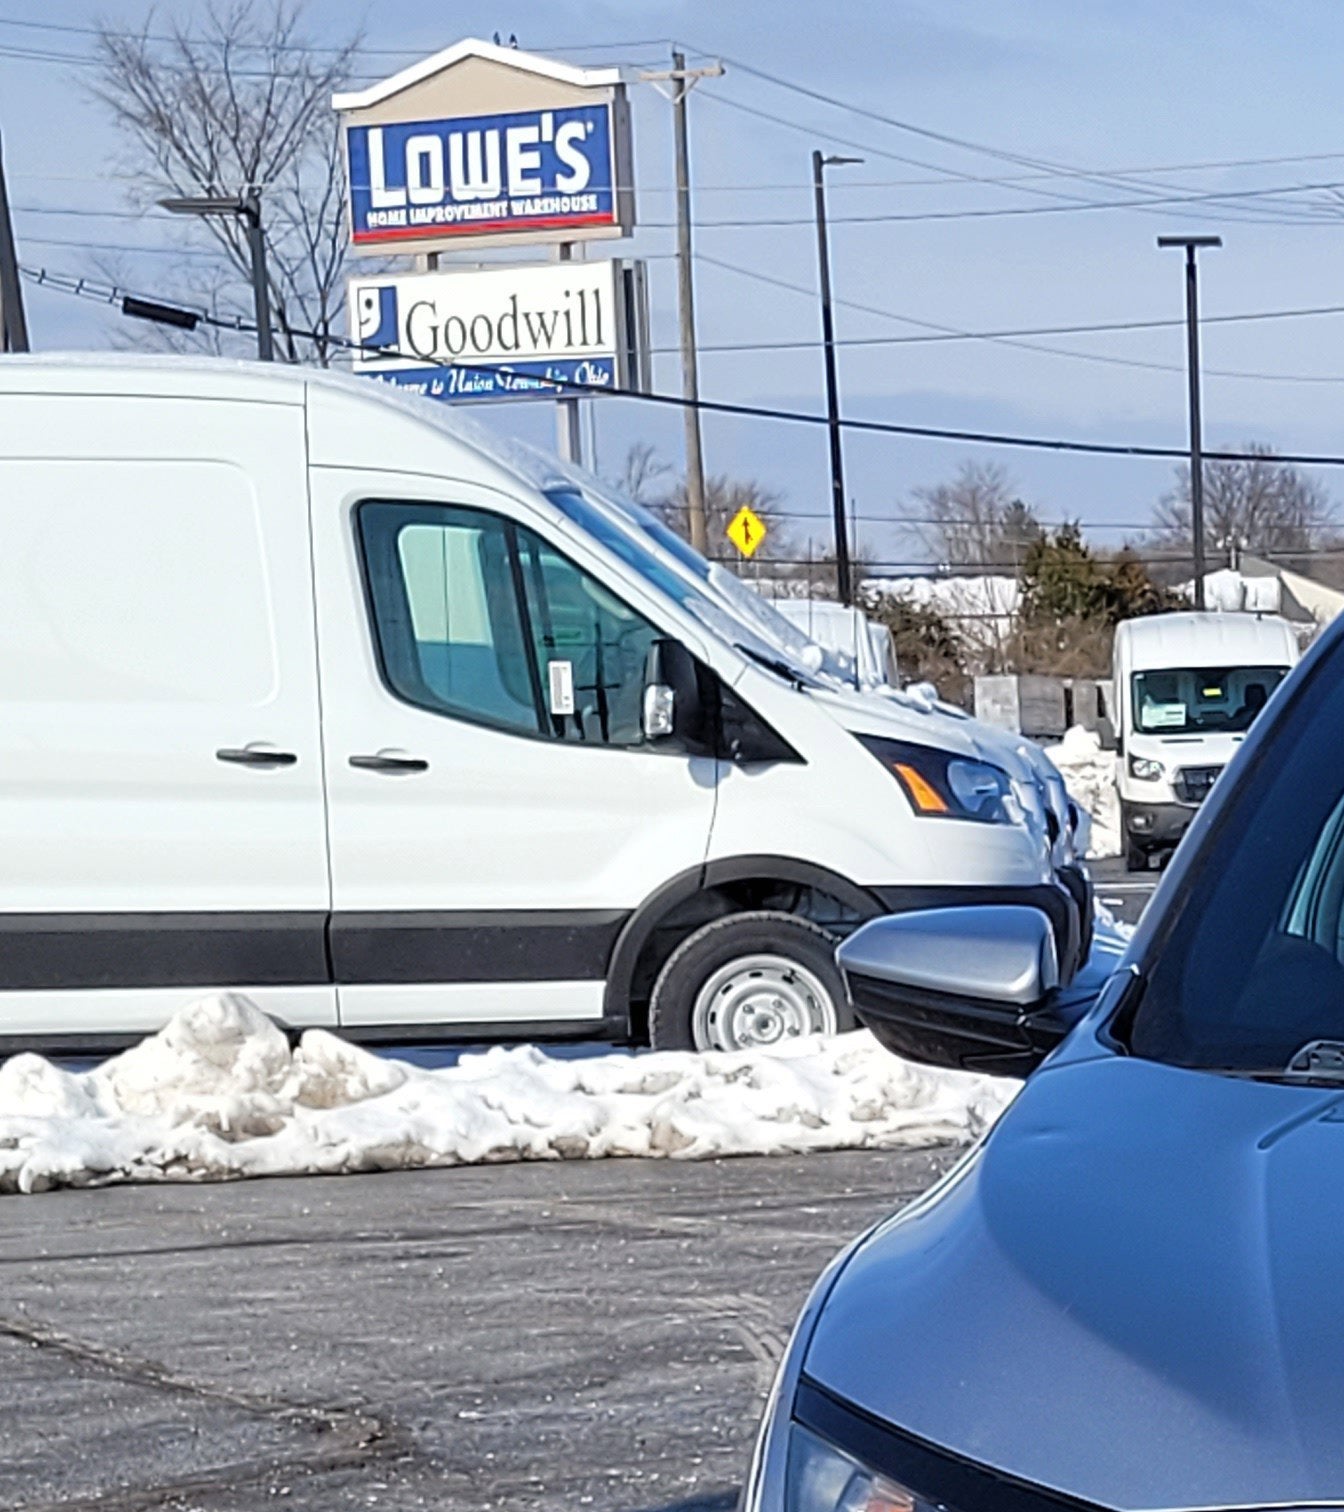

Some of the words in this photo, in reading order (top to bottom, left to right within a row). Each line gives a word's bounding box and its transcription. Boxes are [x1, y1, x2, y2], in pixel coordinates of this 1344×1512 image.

[367, 112, 592, 208] LOWE'S
[367, 208, 407, 228] HOME
[409, 201, 508, 225] IMPROVEMENT
[511, 194, 598, 216] WAREHOUSE
[405, 288, 605, 360] Goodwill
